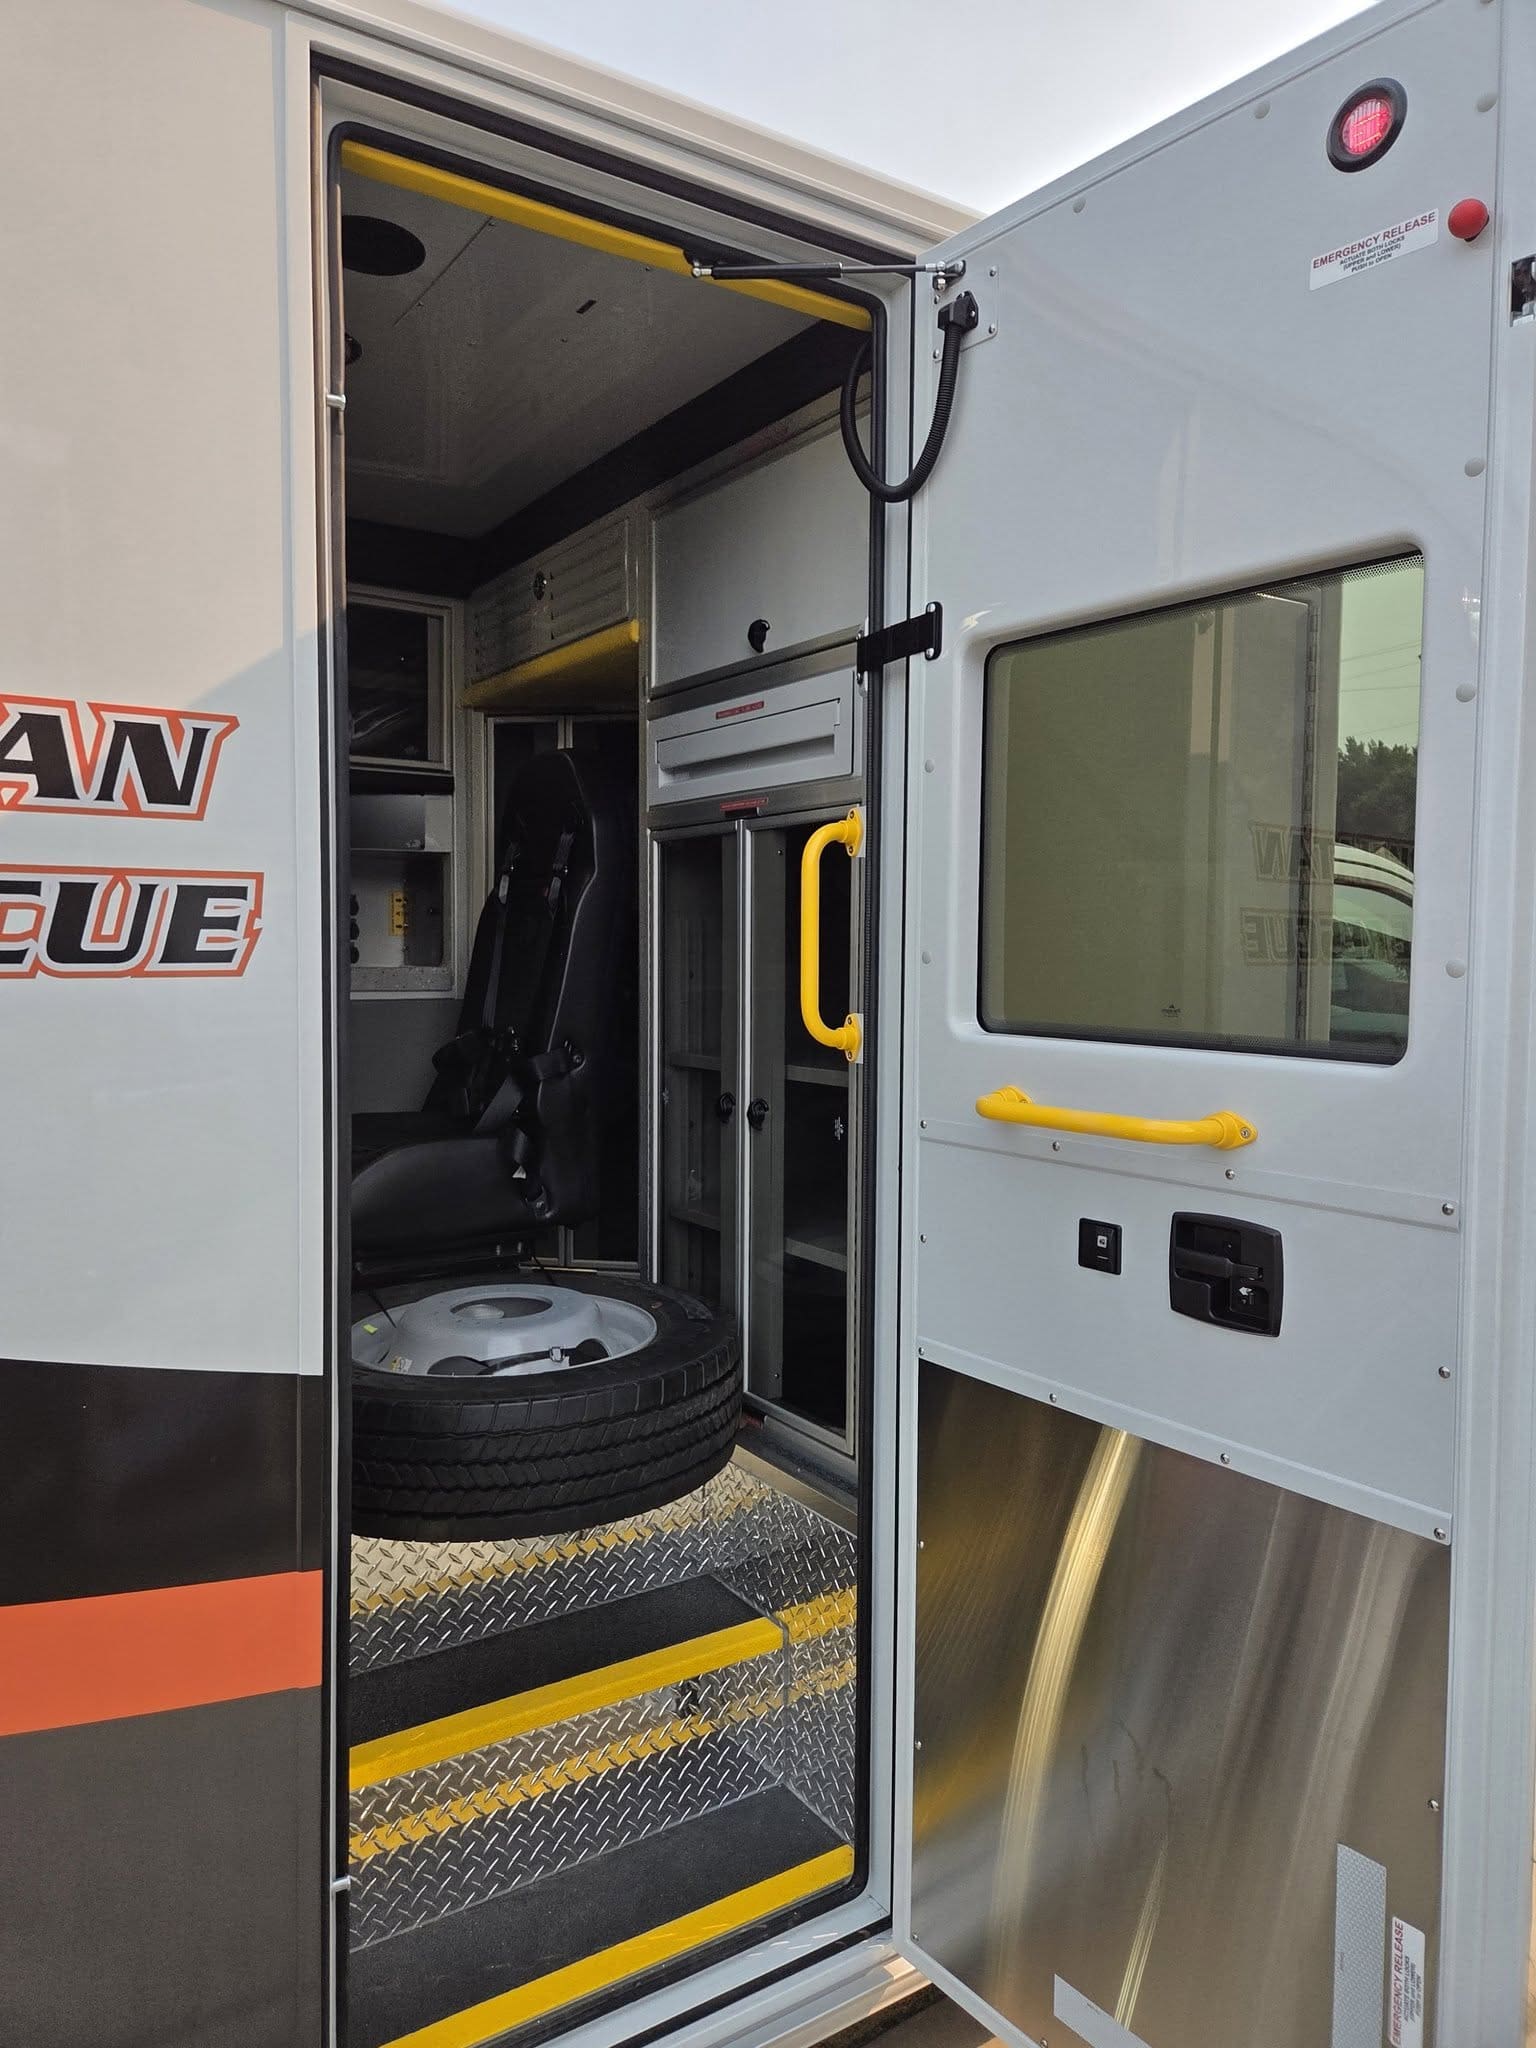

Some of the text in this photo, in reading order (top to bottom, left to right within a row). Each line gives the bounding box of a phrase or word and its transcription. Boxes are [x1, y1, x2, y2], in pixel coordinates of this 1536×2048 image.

[1313, 211, 1436, 269] EMERGENCY RELEASE
[0, 696, 236, 820] AN
[1392, 1921, 1403, 2045] EMERGENCY RELEASE
